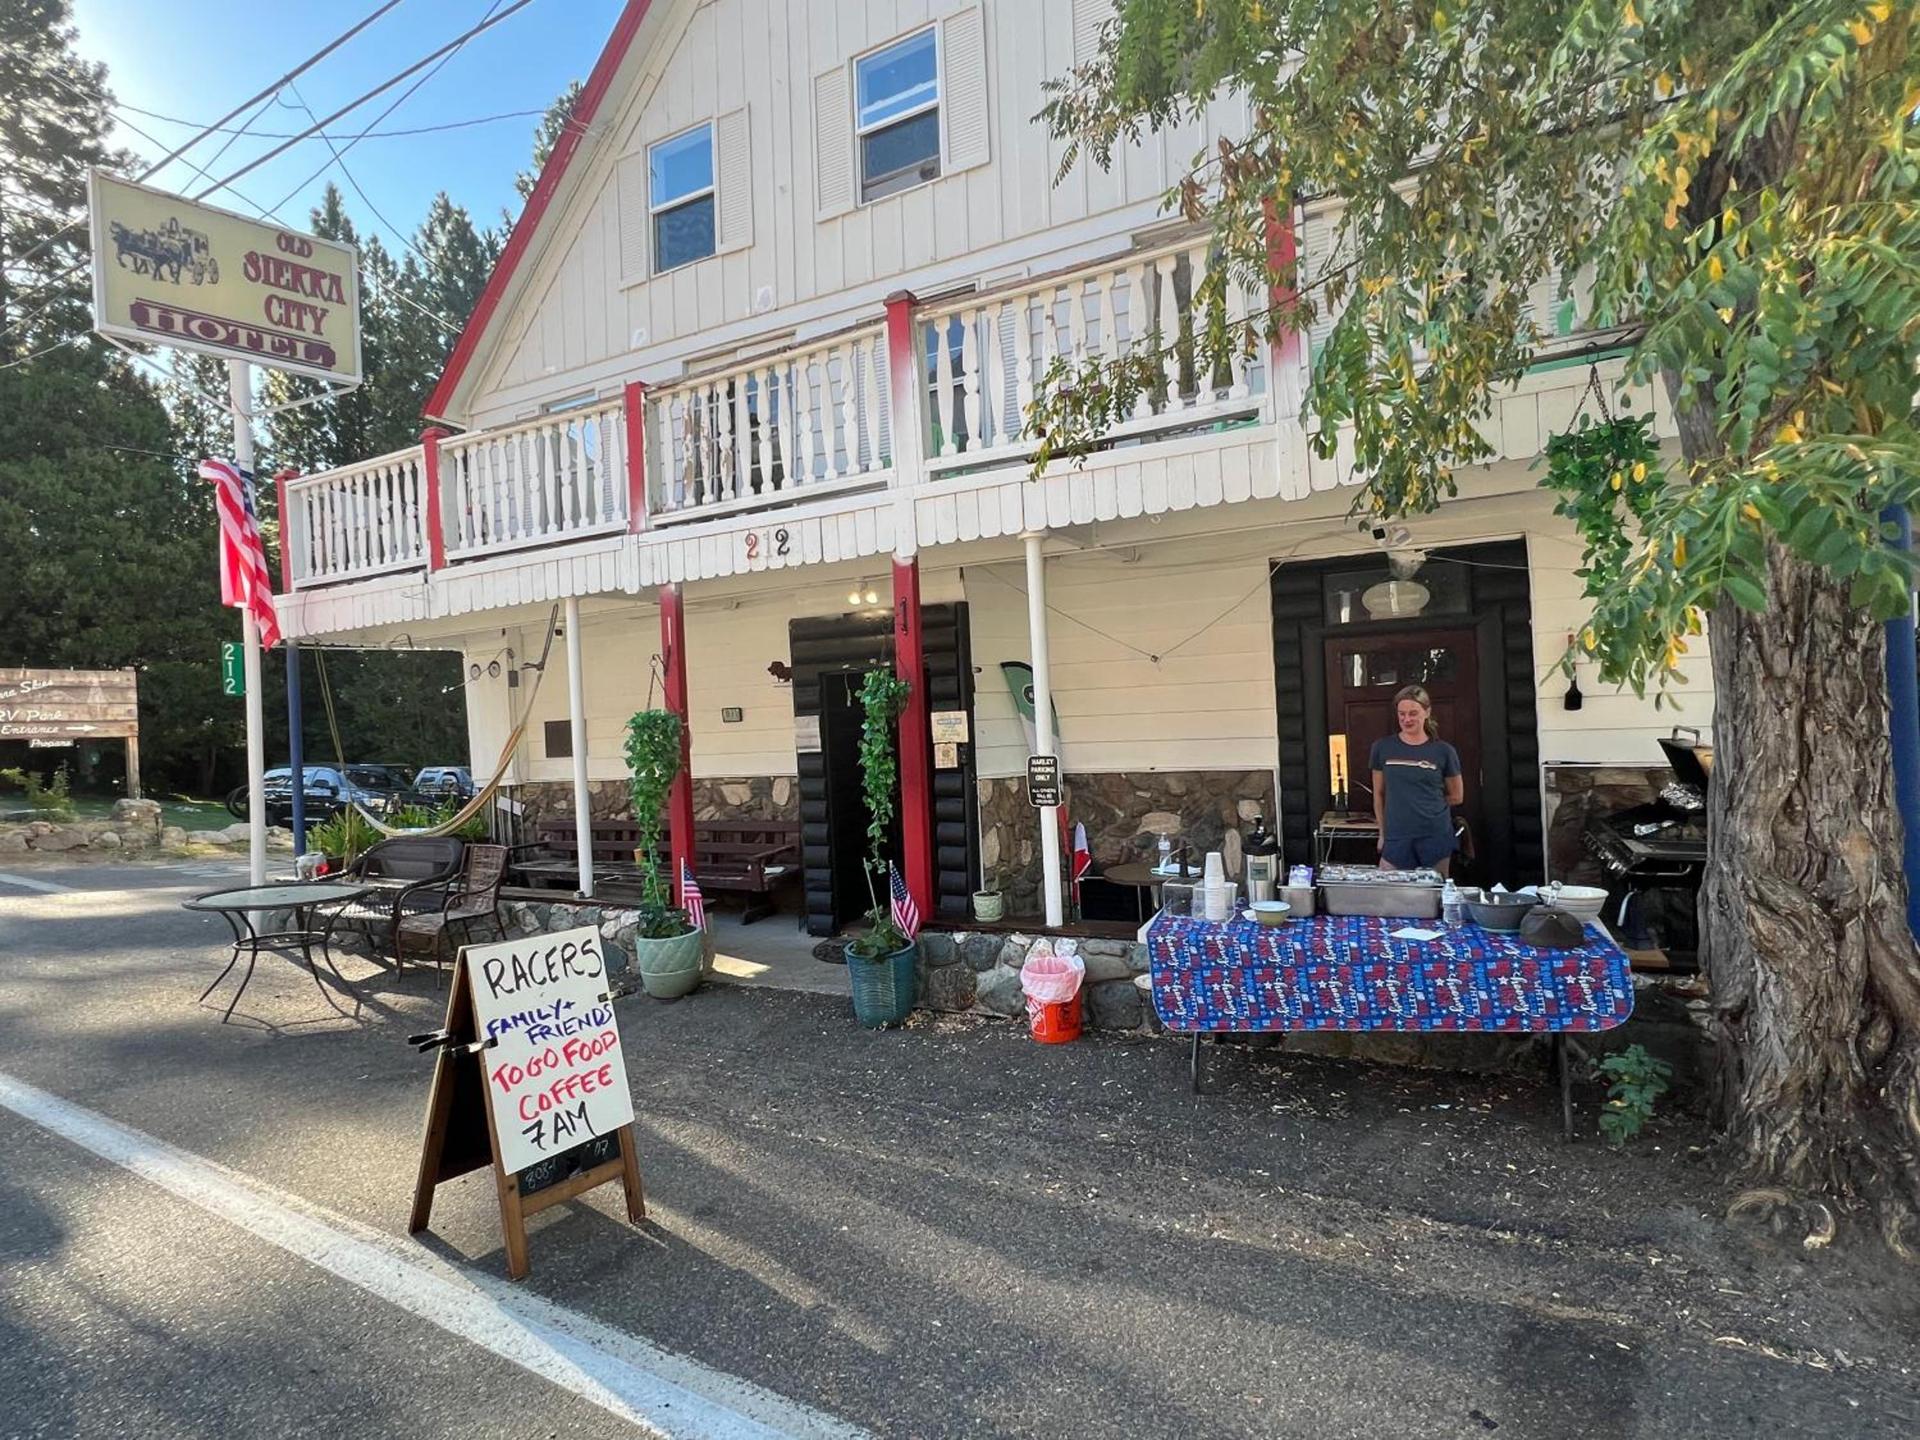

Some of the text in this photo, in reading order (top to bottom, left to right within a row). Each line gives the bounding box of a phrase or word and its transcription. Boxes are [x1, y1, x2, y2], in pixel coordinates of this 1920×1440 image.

[275, 231, 314, 259] OLD
[243, 250, 347, 306] SIERRA
[143, 303, 325, 363] HOTEL
[264, 293, 330, 337] CITY
[224, 643, 236, 694] 212
[1, 724, 60, 736] Entrance
[26, 709, 63, 722] Park
[483, 938, 603, 1000] RACERS
[525, 1003, 613, 1046] FRIENDS
[562, 1030, 617, 1067] FOOD
[518, 1063, 614, 1121] COFFEE
